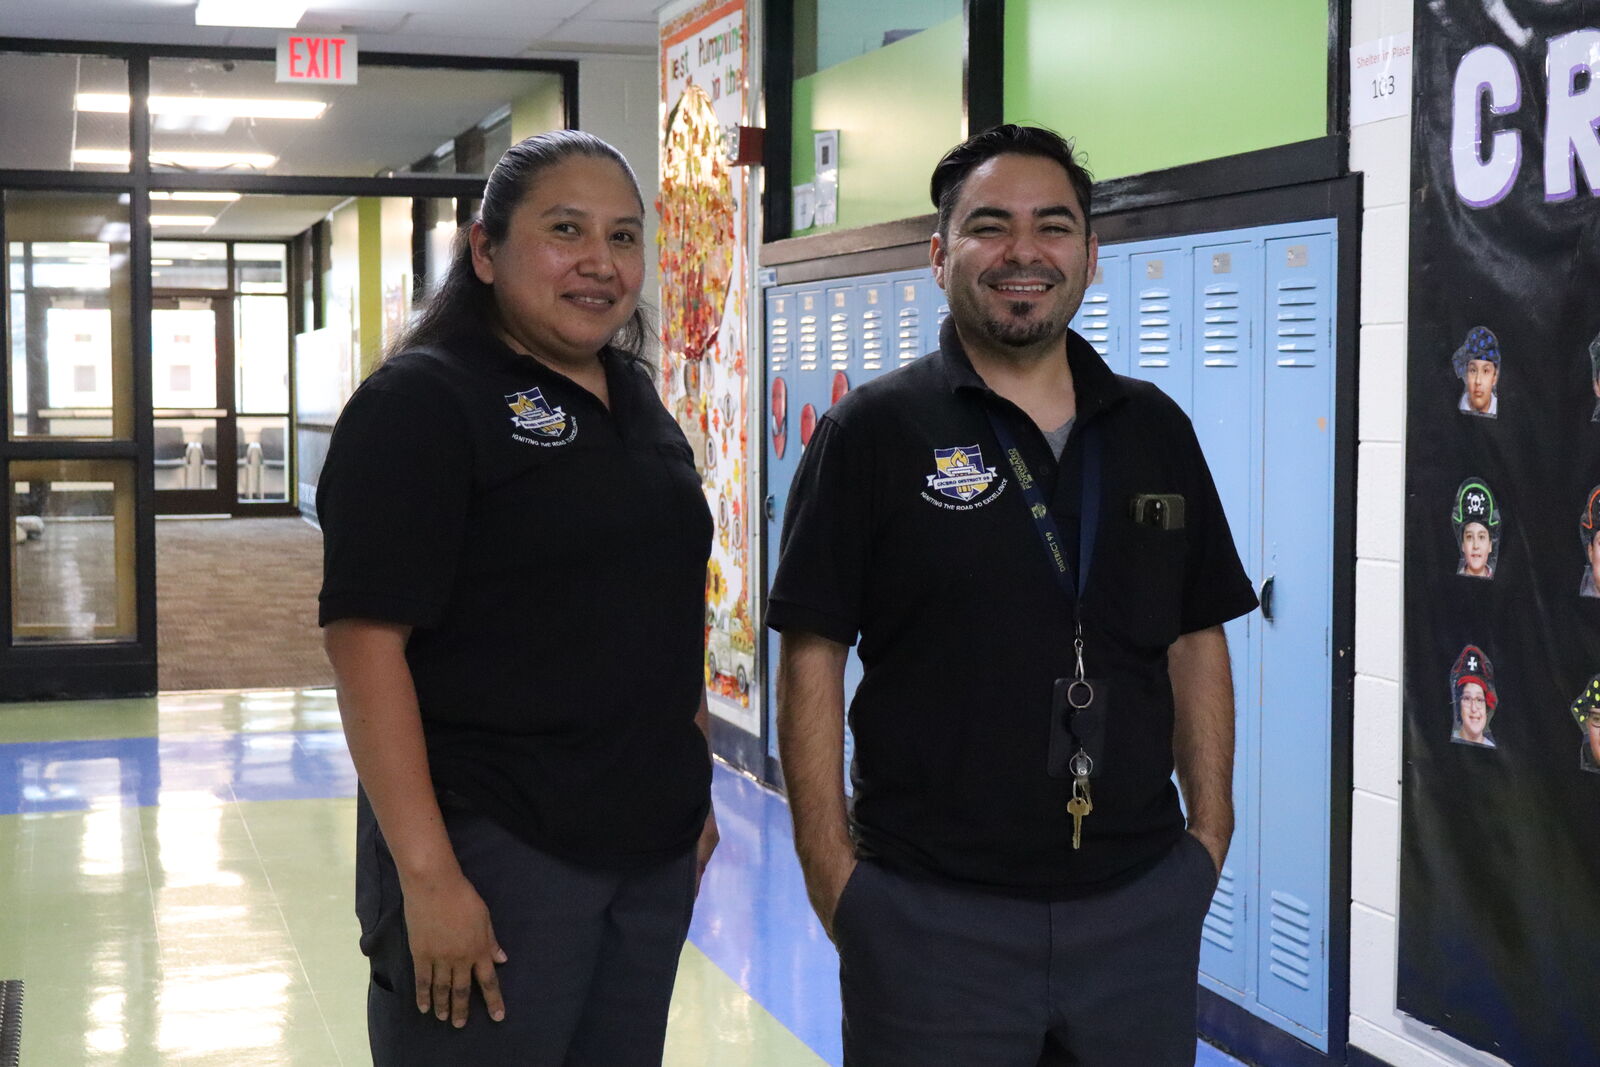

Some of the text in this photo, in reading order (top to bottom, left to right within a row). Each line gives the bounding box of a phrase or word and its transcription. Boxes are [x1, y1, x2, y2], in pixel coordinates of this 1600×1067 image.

[288, 36, 347, 80] EXIT
[1371, 75, 1395, 99] 103
[920, 491, 943, 508] IGNITING
[944, 502, 956, 511] THE
[982, 477, 1009, 505] EXCELLENCE
[1045, 531, 1066, 572] DISTRICT 99
